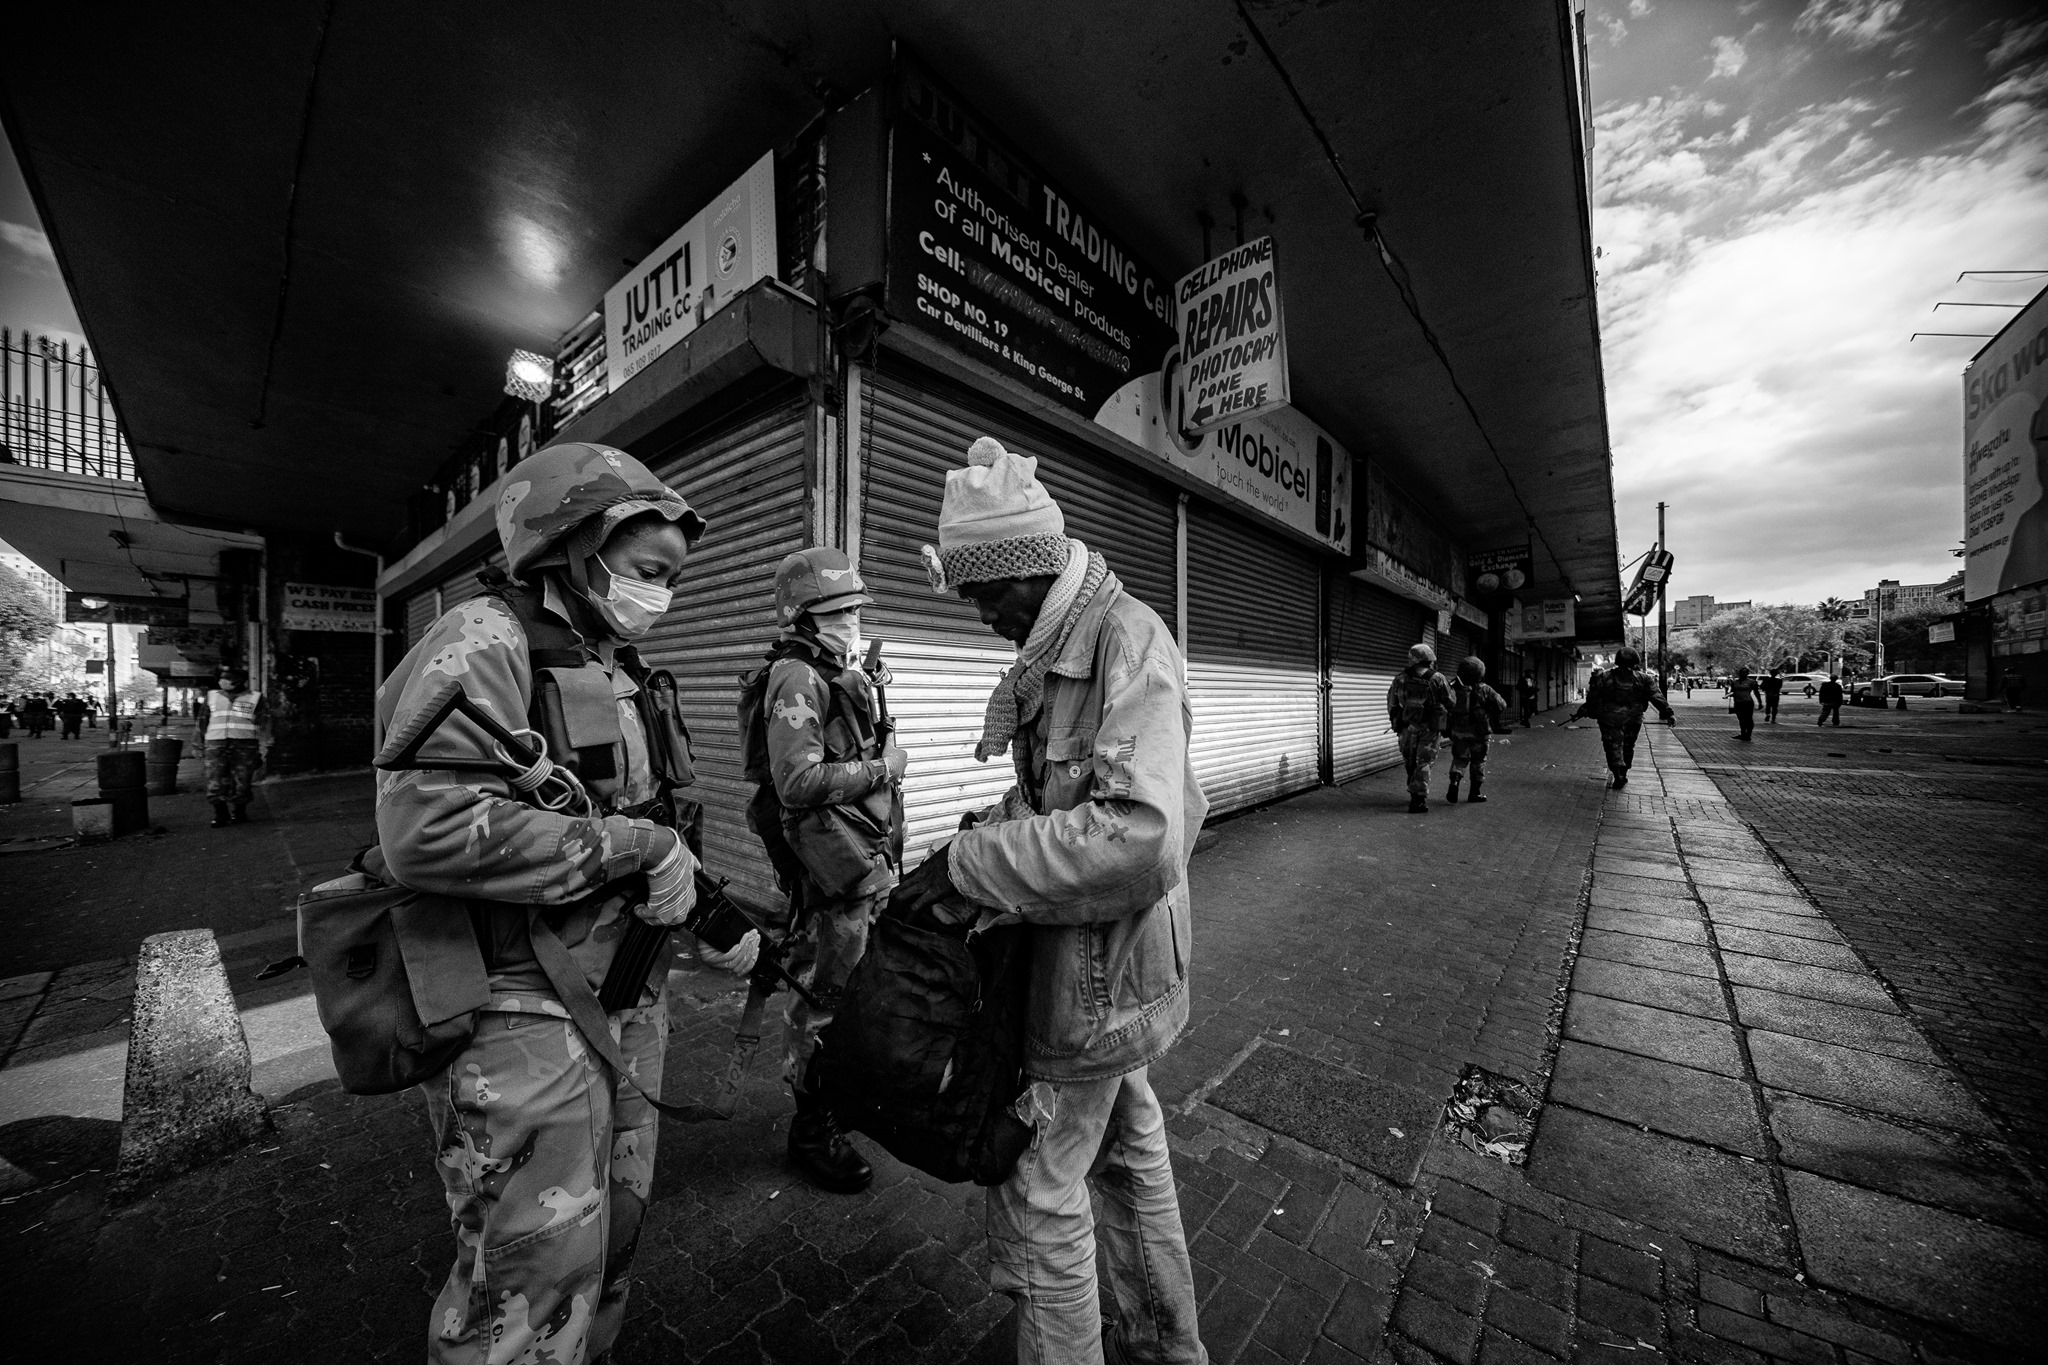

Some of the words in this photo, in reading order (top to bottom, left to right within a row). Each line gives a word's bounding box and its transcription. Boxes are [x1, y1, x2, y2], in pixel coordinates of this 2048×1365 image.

[919, 230, 966, 276] Cell:
[937, 167, 1040, 258] Authorised
[1046, 250, 1095, 298] Dealer
[1043, 185, 1137, 295] TRADING
[622, 241, 691, 336] JUTTI
[934, 200, 957, 224] of
[962, 217, 984, 246] all
[991, 232, 1070, 306] Mobicel
[1074, 299, 1131, 350] products
[1180, 237, 1272, 304] CELLPHONE
[622, 311, 672, 357] TRADING
[674, 293, 692, 319] CC
[917, 273, 960, 308] SHOP
[964, 301, 989, 328] NO.
[994, 319, 1008, 337] 19
[1182, 271, 1273, 365] REPAIRS
[917, 297, 941, 320] Cnr
[944, 314, 1000, 353] Devilliers
[1002, 345, 1011, 358] &
[1013, 351, 1036, 375] King
[1038, 366, 1073, 397] George
[1075, 386, 1086, 401] St.
[1188, 331, 1279, 392] PHOTOCOPY
[1198, 372, 1242, 404] DONE
[1218, 382, 1268, 415] HERE
[1216, 461, 1244, 490] touch
[1246, 474, 1260, 497] the
[1262, 485, 1285, 512] world
[1217, 423, 1311, 502] Mobicel
[1988, 472, 2020, 497] WhatsApp
[1469, 558, 1485, 567] Gold
[1497, 552, 1529, 562] Diamond
[1481, 562, 1518, 571] Exchange
[292, 599, 330, 610] CASH
[334, 602, 376, 612] PRICES
[320, 588, 348, 599] PAY
